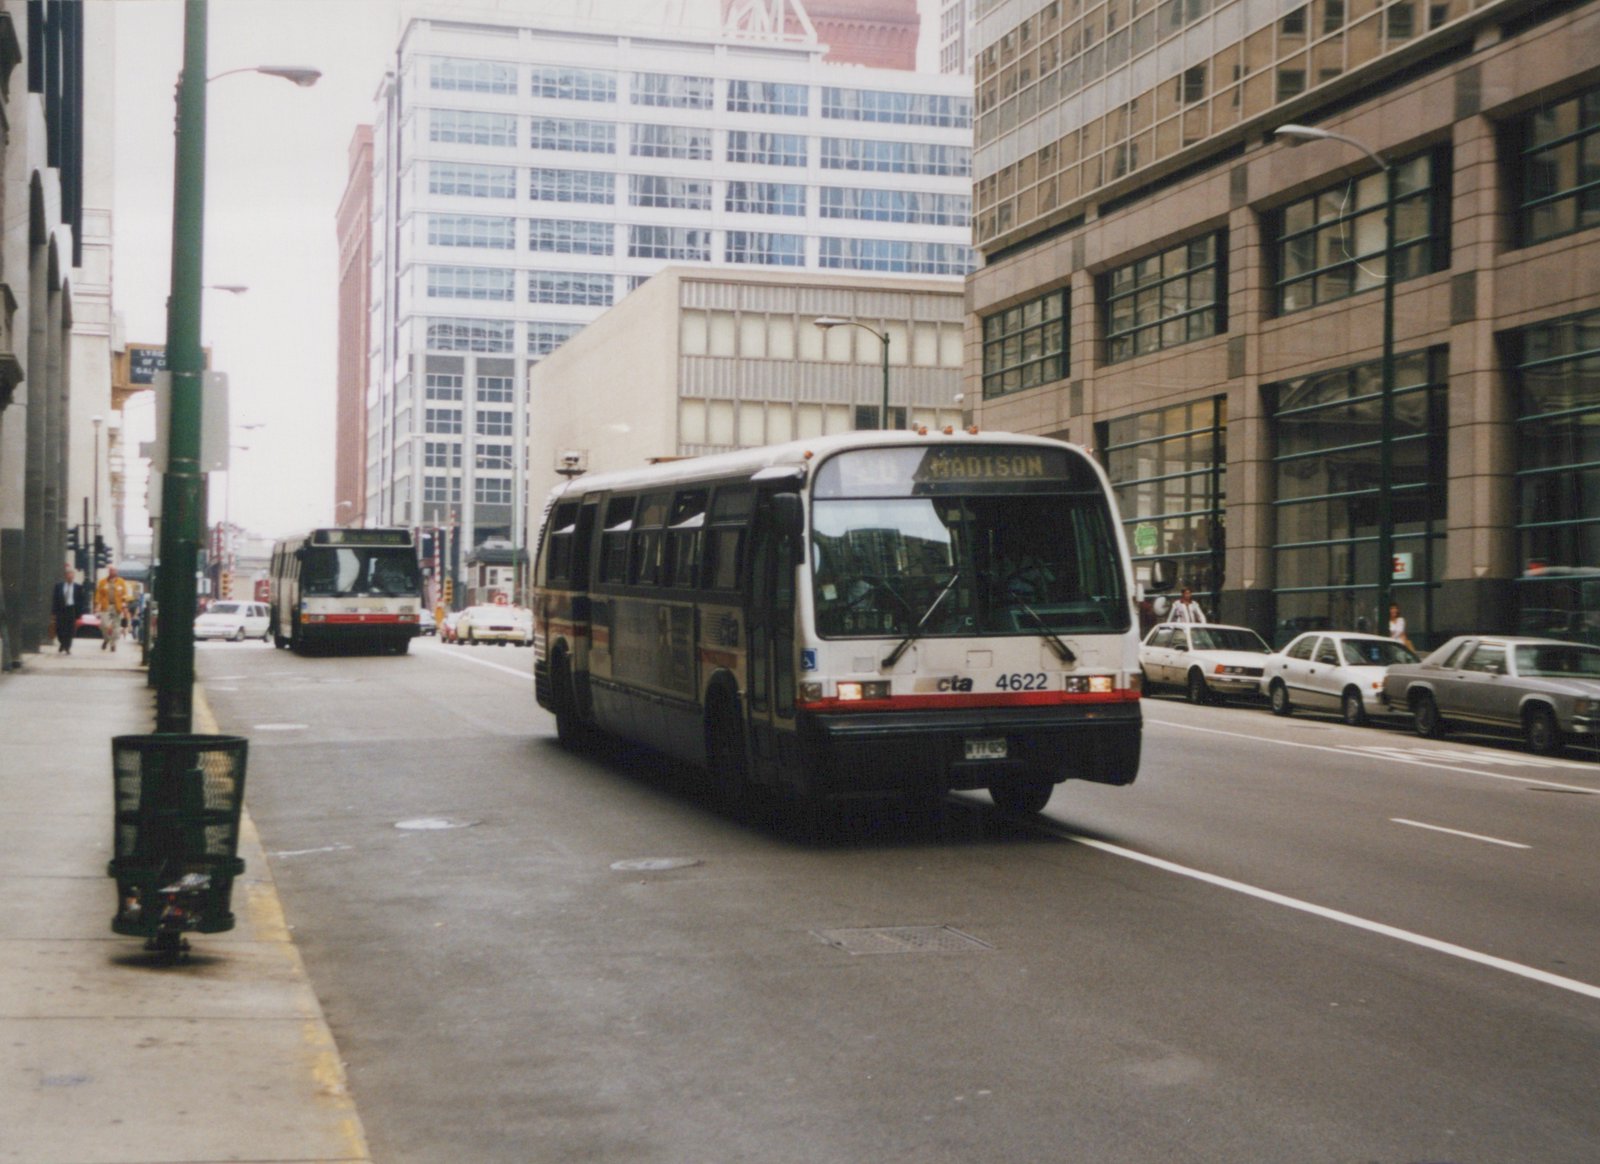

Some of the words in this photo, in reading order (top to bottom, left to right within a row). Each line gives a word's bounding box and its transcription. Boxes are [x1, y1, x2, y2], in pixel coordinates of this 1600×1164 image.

[931, 456, 1043, 479] MADISON
[937, 675, 973, 692] cta
[995, 673, 1048, 691] 4622
